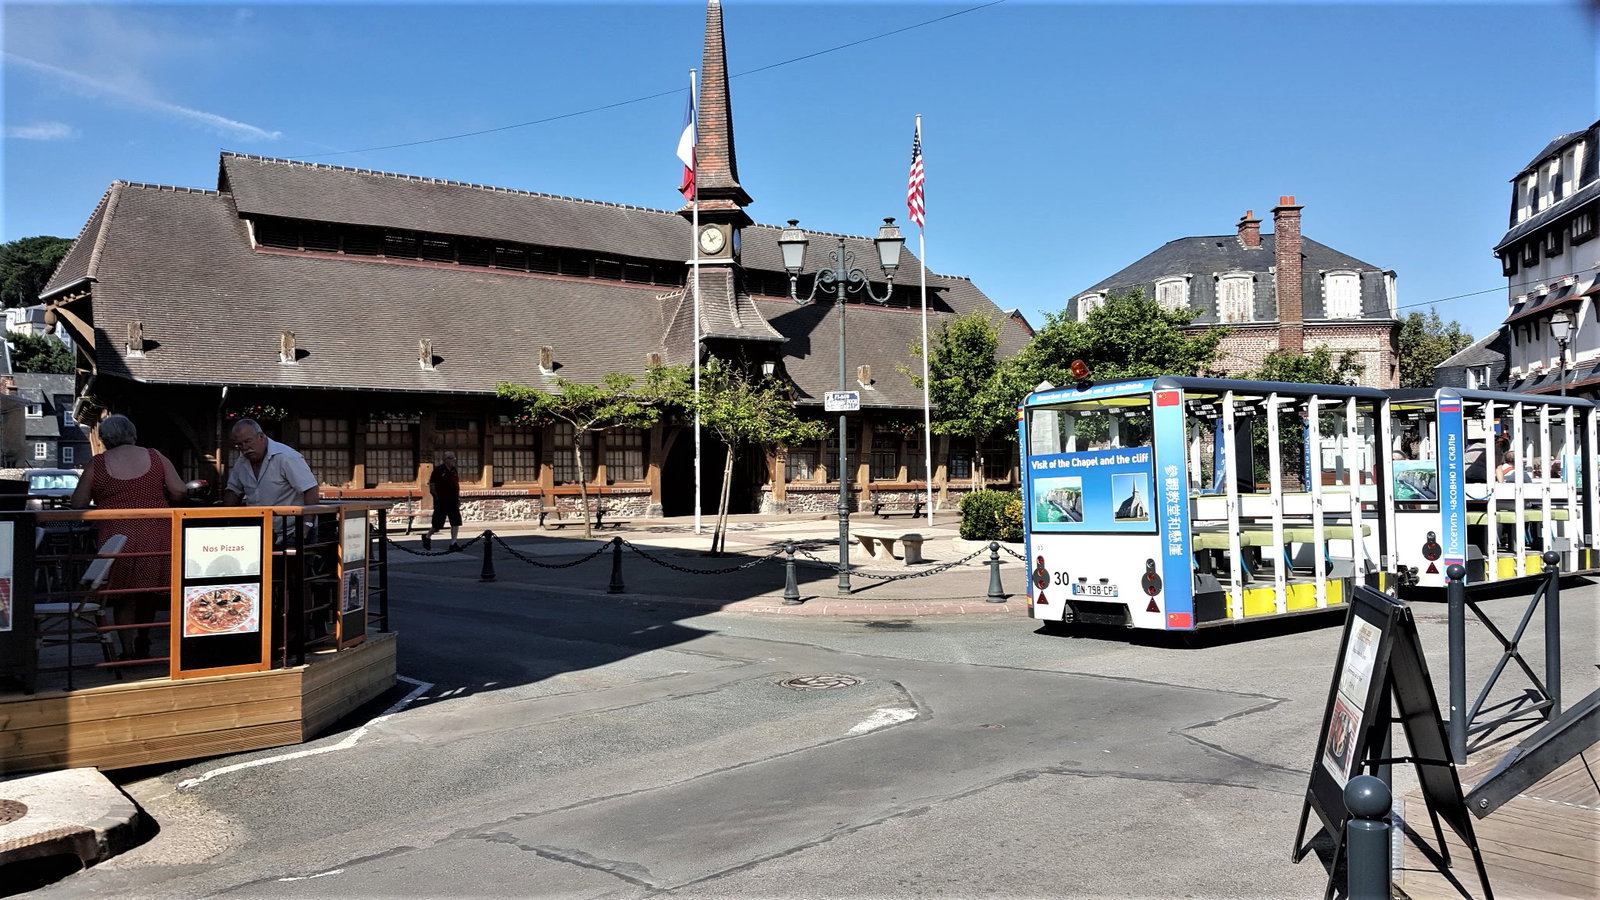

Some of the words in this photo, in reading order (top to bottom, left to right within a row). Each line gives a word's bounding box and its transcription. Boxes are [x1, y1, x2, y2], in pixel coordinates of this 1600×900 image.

[1031, 460, 1048, 470] Visit
[1049, 459, 1057, 468] of
[1058, 459, 1070, 468] the
[1071, 457, 1098, 468] Chapel
[1100, 456, 1114, 465] and
[1116, 455, 1130, 463] the
[1132, 453, 1148, 463] cliff
[1449, 471, 1457, 510] часовню
[1449, 512, 1458, 554] Посетить
[1054, 571, 1069, 586] 30
